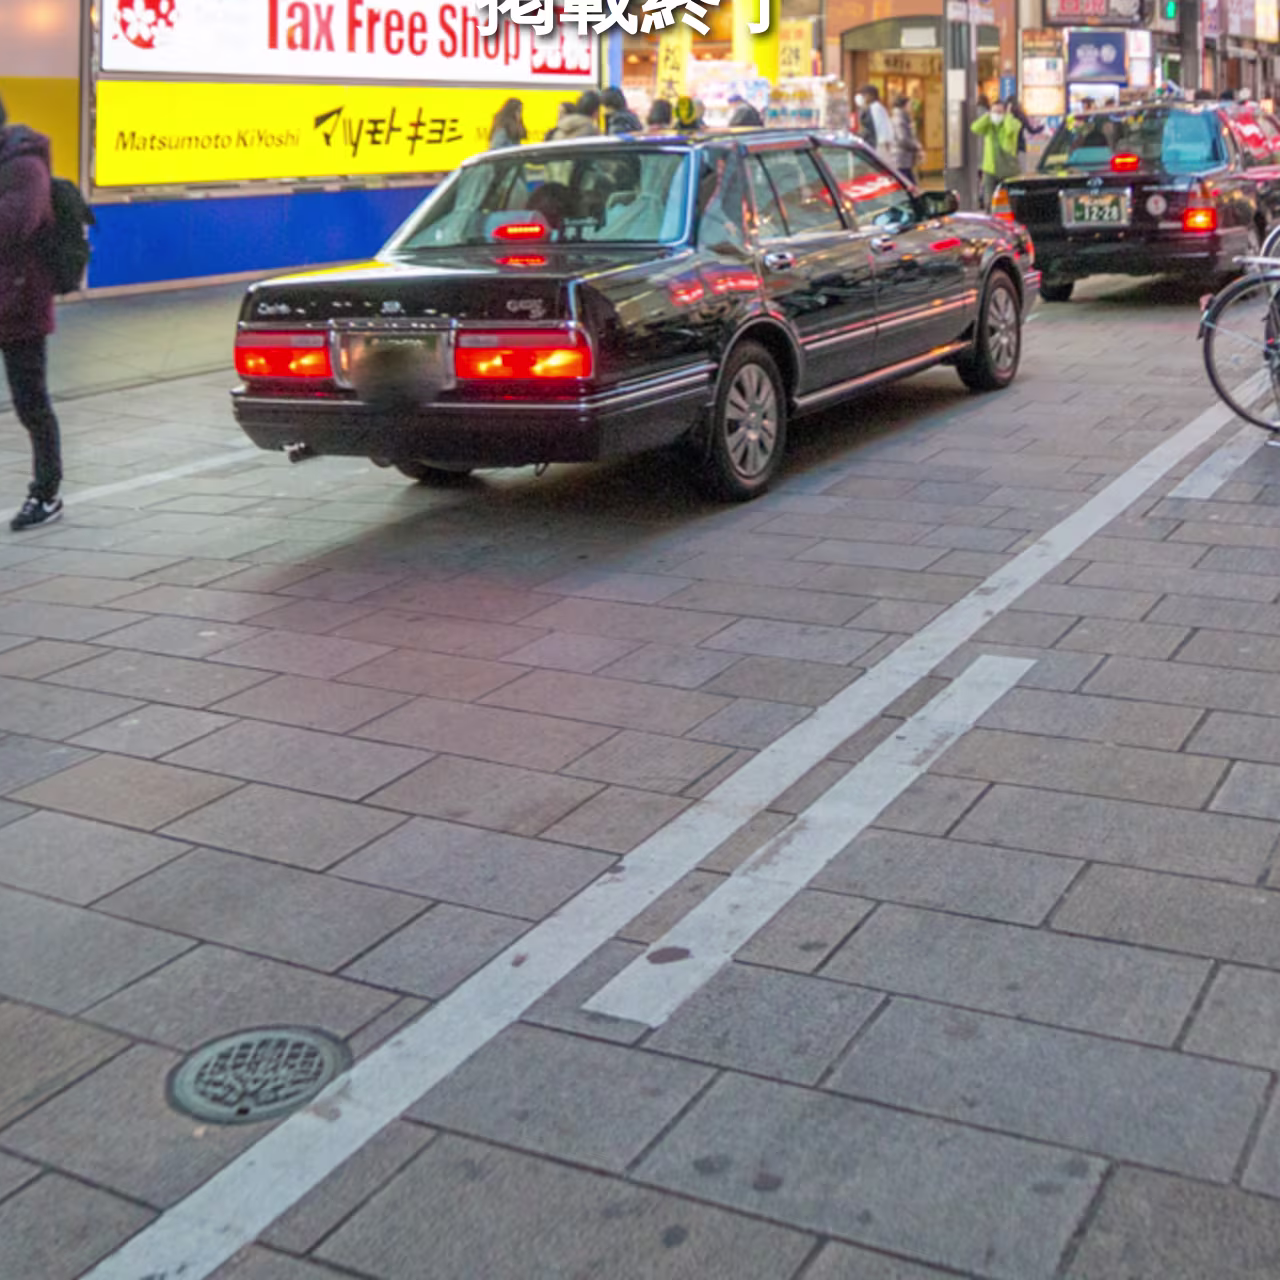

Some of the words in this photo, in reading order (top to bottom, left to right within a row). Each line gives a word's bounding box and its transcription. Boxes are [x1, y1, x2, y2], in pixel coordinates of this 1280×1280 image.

[114, 130, 232, 152] Matsumoto
[235, 128, 300, 149] KiYoshi
[314, 106, 464, 158] マツモトキヨシ
[1084, 206, 1119, 221] 12-28
